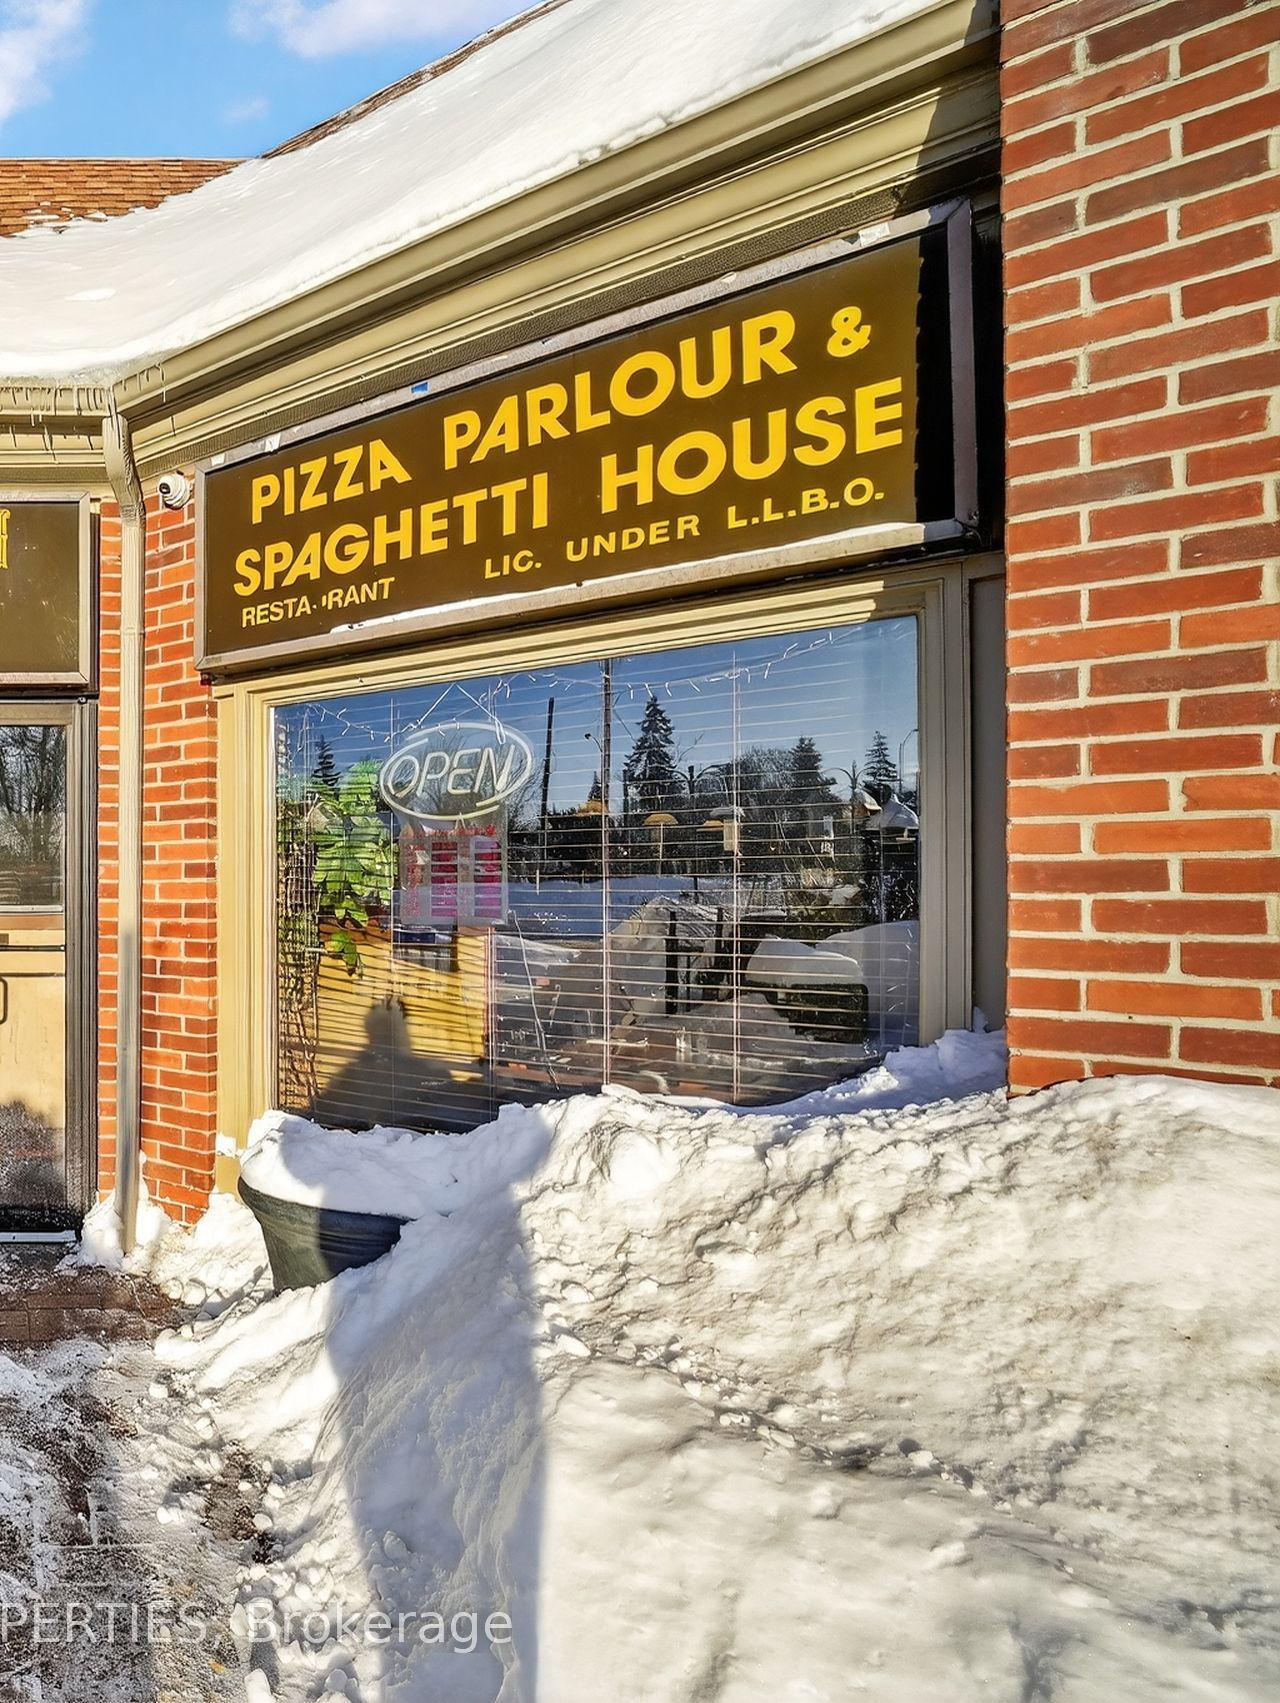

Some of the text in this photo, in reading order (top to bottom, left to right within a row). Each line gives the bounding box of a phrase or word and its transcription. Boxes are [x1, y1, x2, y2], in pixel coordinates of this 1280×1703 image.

[233, 376, 903, 597] SPAGHETTI HOUSE
[251, 305, 872, 525] PIZZA PARLOUR &
[484, 477, 885, 580] LIC. UNDER L.L.B.O.
[387, 743, 516, 798] OPEN
